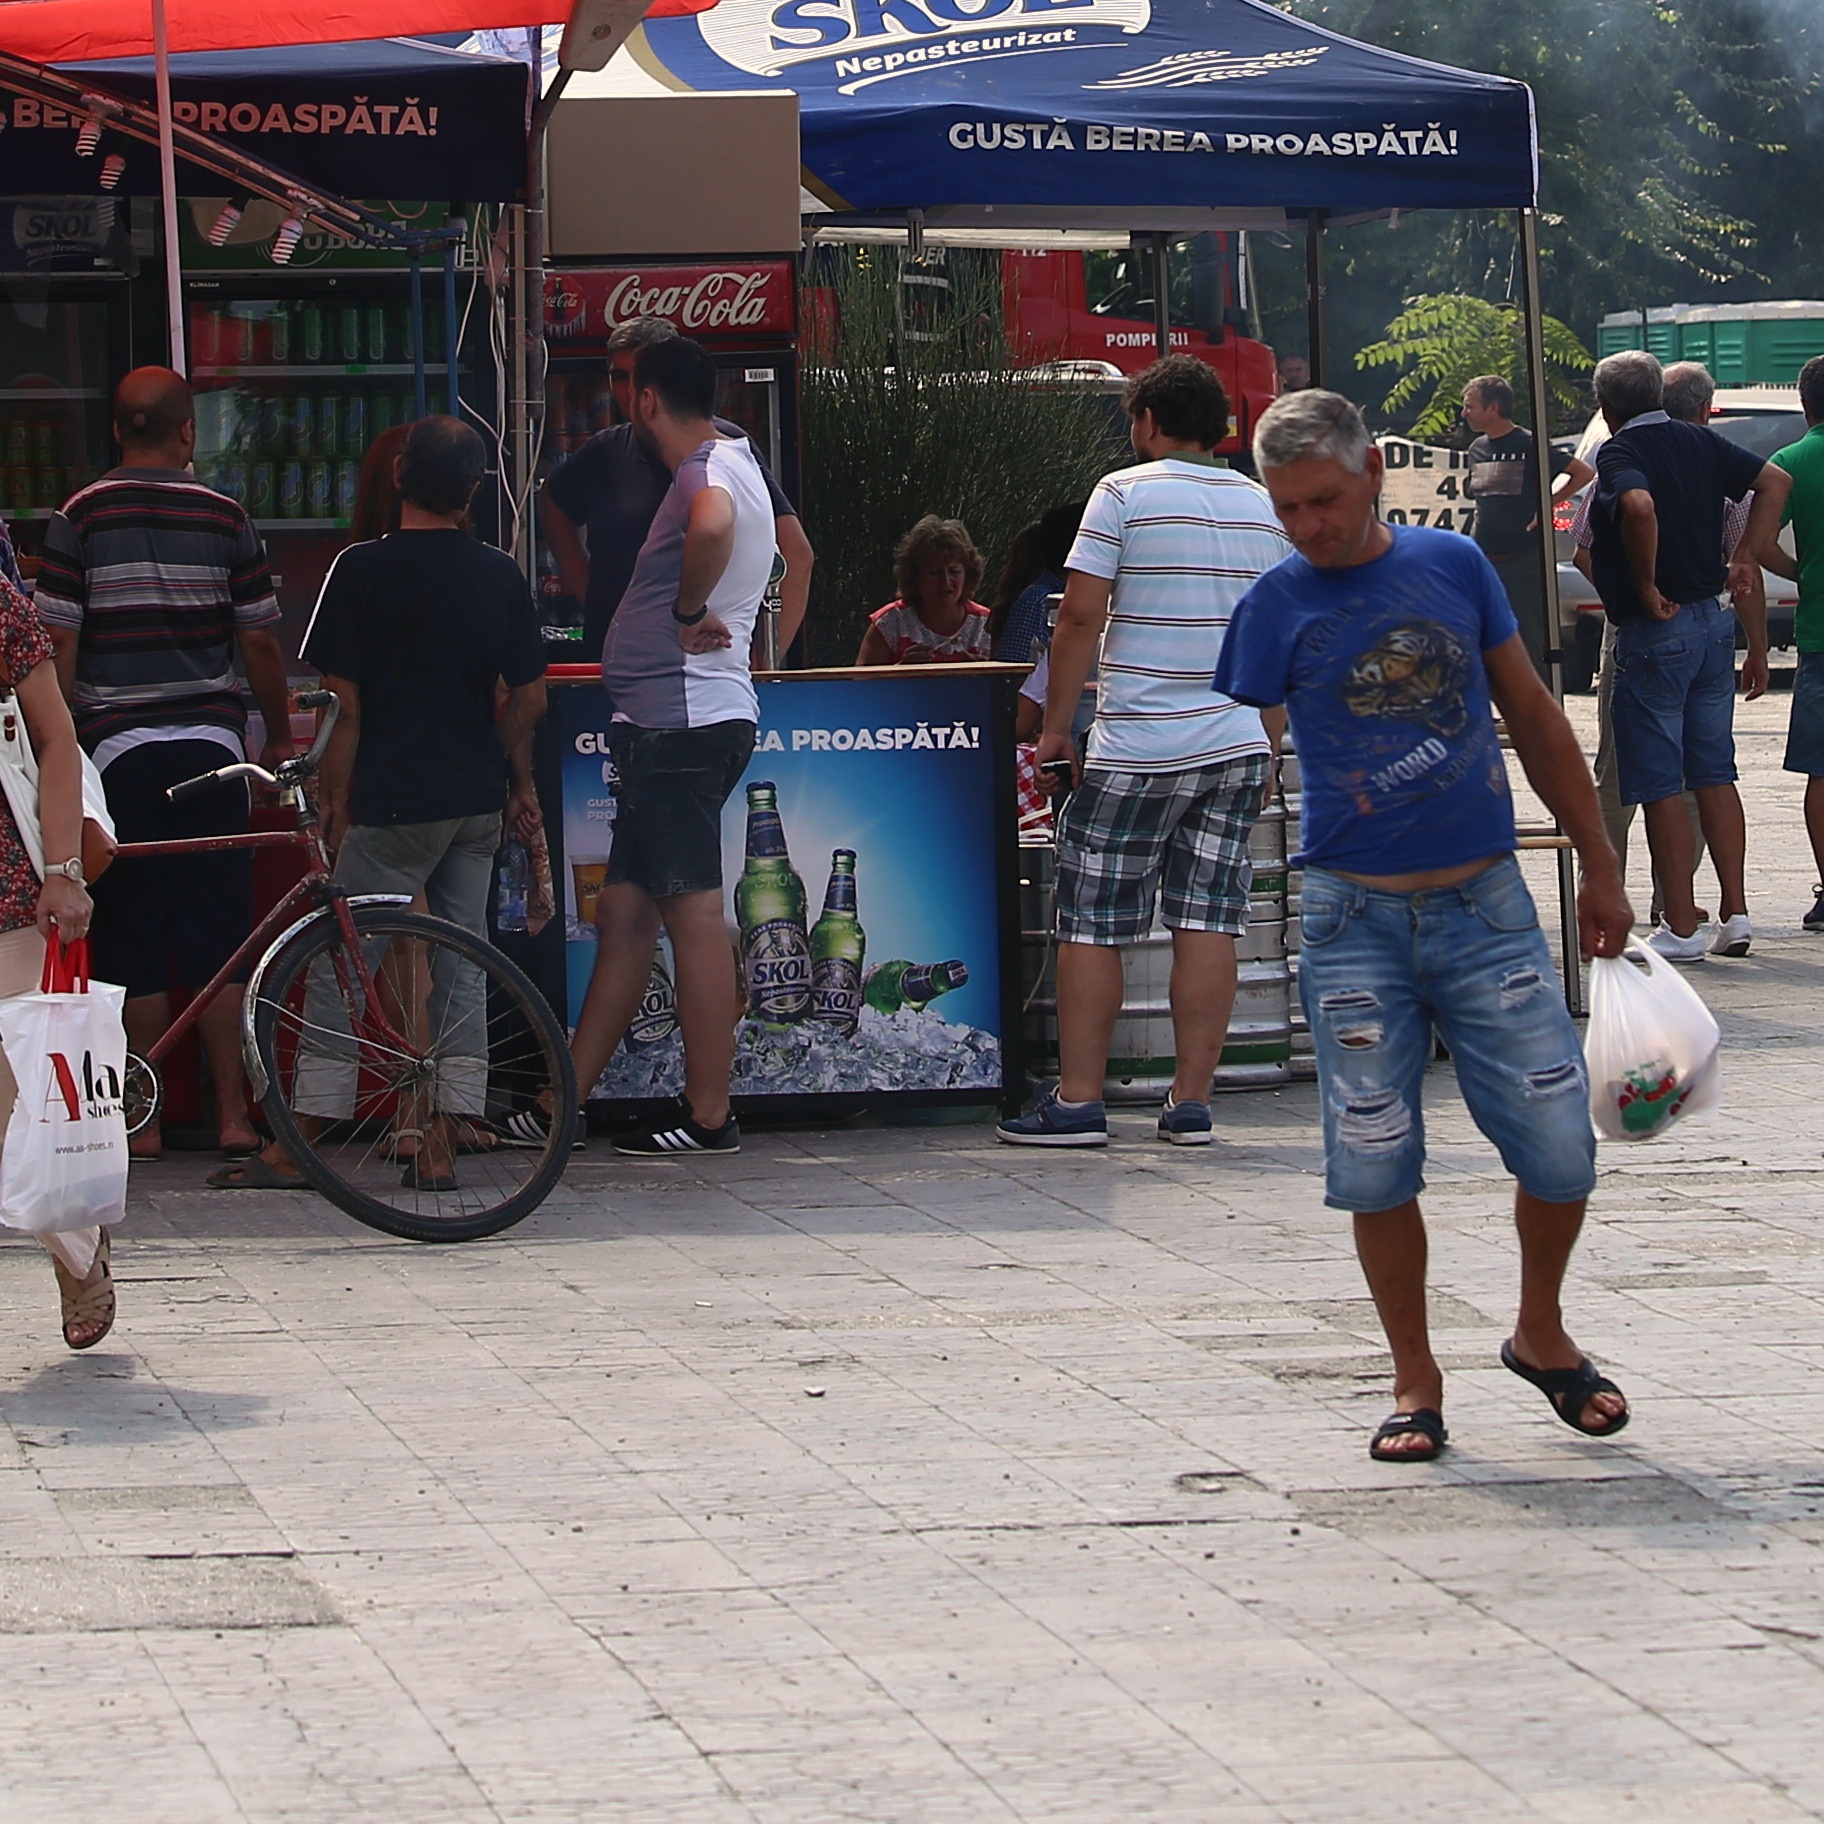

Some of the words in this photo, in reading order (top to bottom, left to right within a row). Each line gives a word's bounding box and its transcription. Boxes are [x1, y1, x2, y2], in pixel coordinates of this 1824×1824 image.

[834, 28, 1078, 78] Nepasteurizat
[172, 96, 438, 136] PROASPĂTĂ!
[948, 117, 1076, 152] GUSTĂ
[1086, 125, 1215, 154] BEREA
[1226, 121, 1460, 157] PROASPĂTĂ!
[604, 271, 772, 329] Coca-Cola
[1105, 332, 1189, 348] POMPIRII
[1384, 441, 1434, 470] DE
[792, 721, 981, 752] PROASPĂTĂ!
[1370, 736, 1449, 793] WORLD
[587, 798, 618, 808] GUST
[752, 959, 811, 985] SKOL
